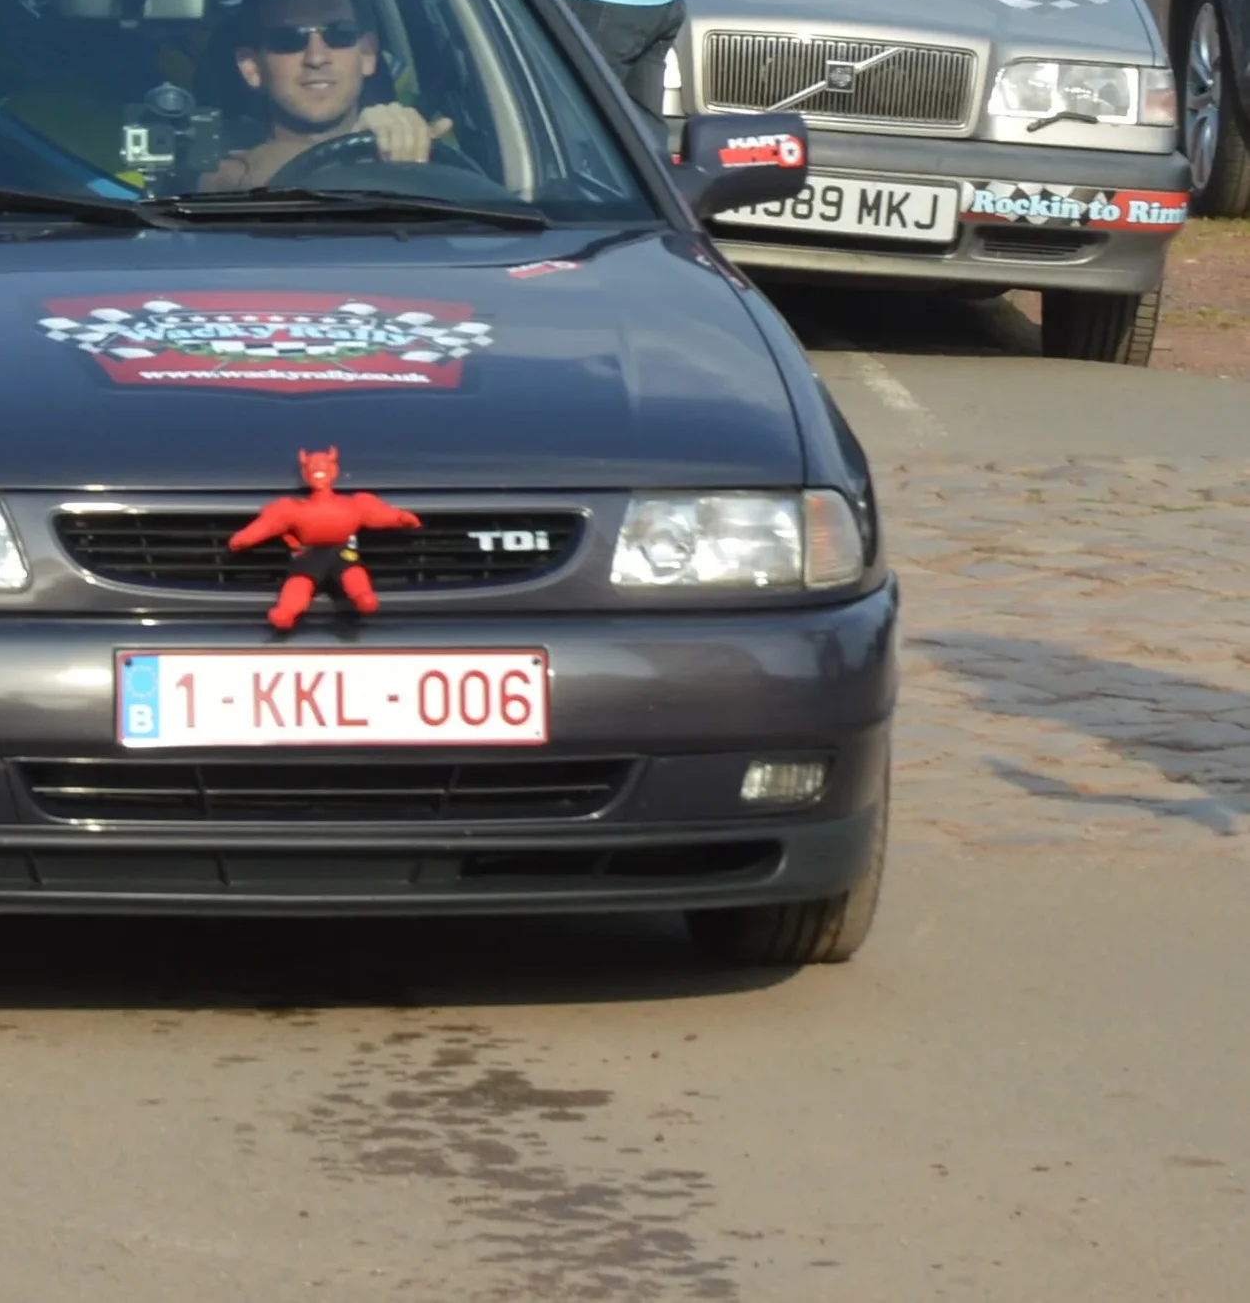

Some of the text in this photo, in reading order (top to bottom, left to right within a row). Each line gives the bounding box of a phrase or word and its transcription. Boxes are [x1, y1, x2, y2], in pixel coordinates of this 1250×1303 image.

[857, 188, 939, 230] MKJ
[971, 189, 1081, 219] Rockin
[1088, 202, 1121, 222] to
[129, 704, 154, 734] B
